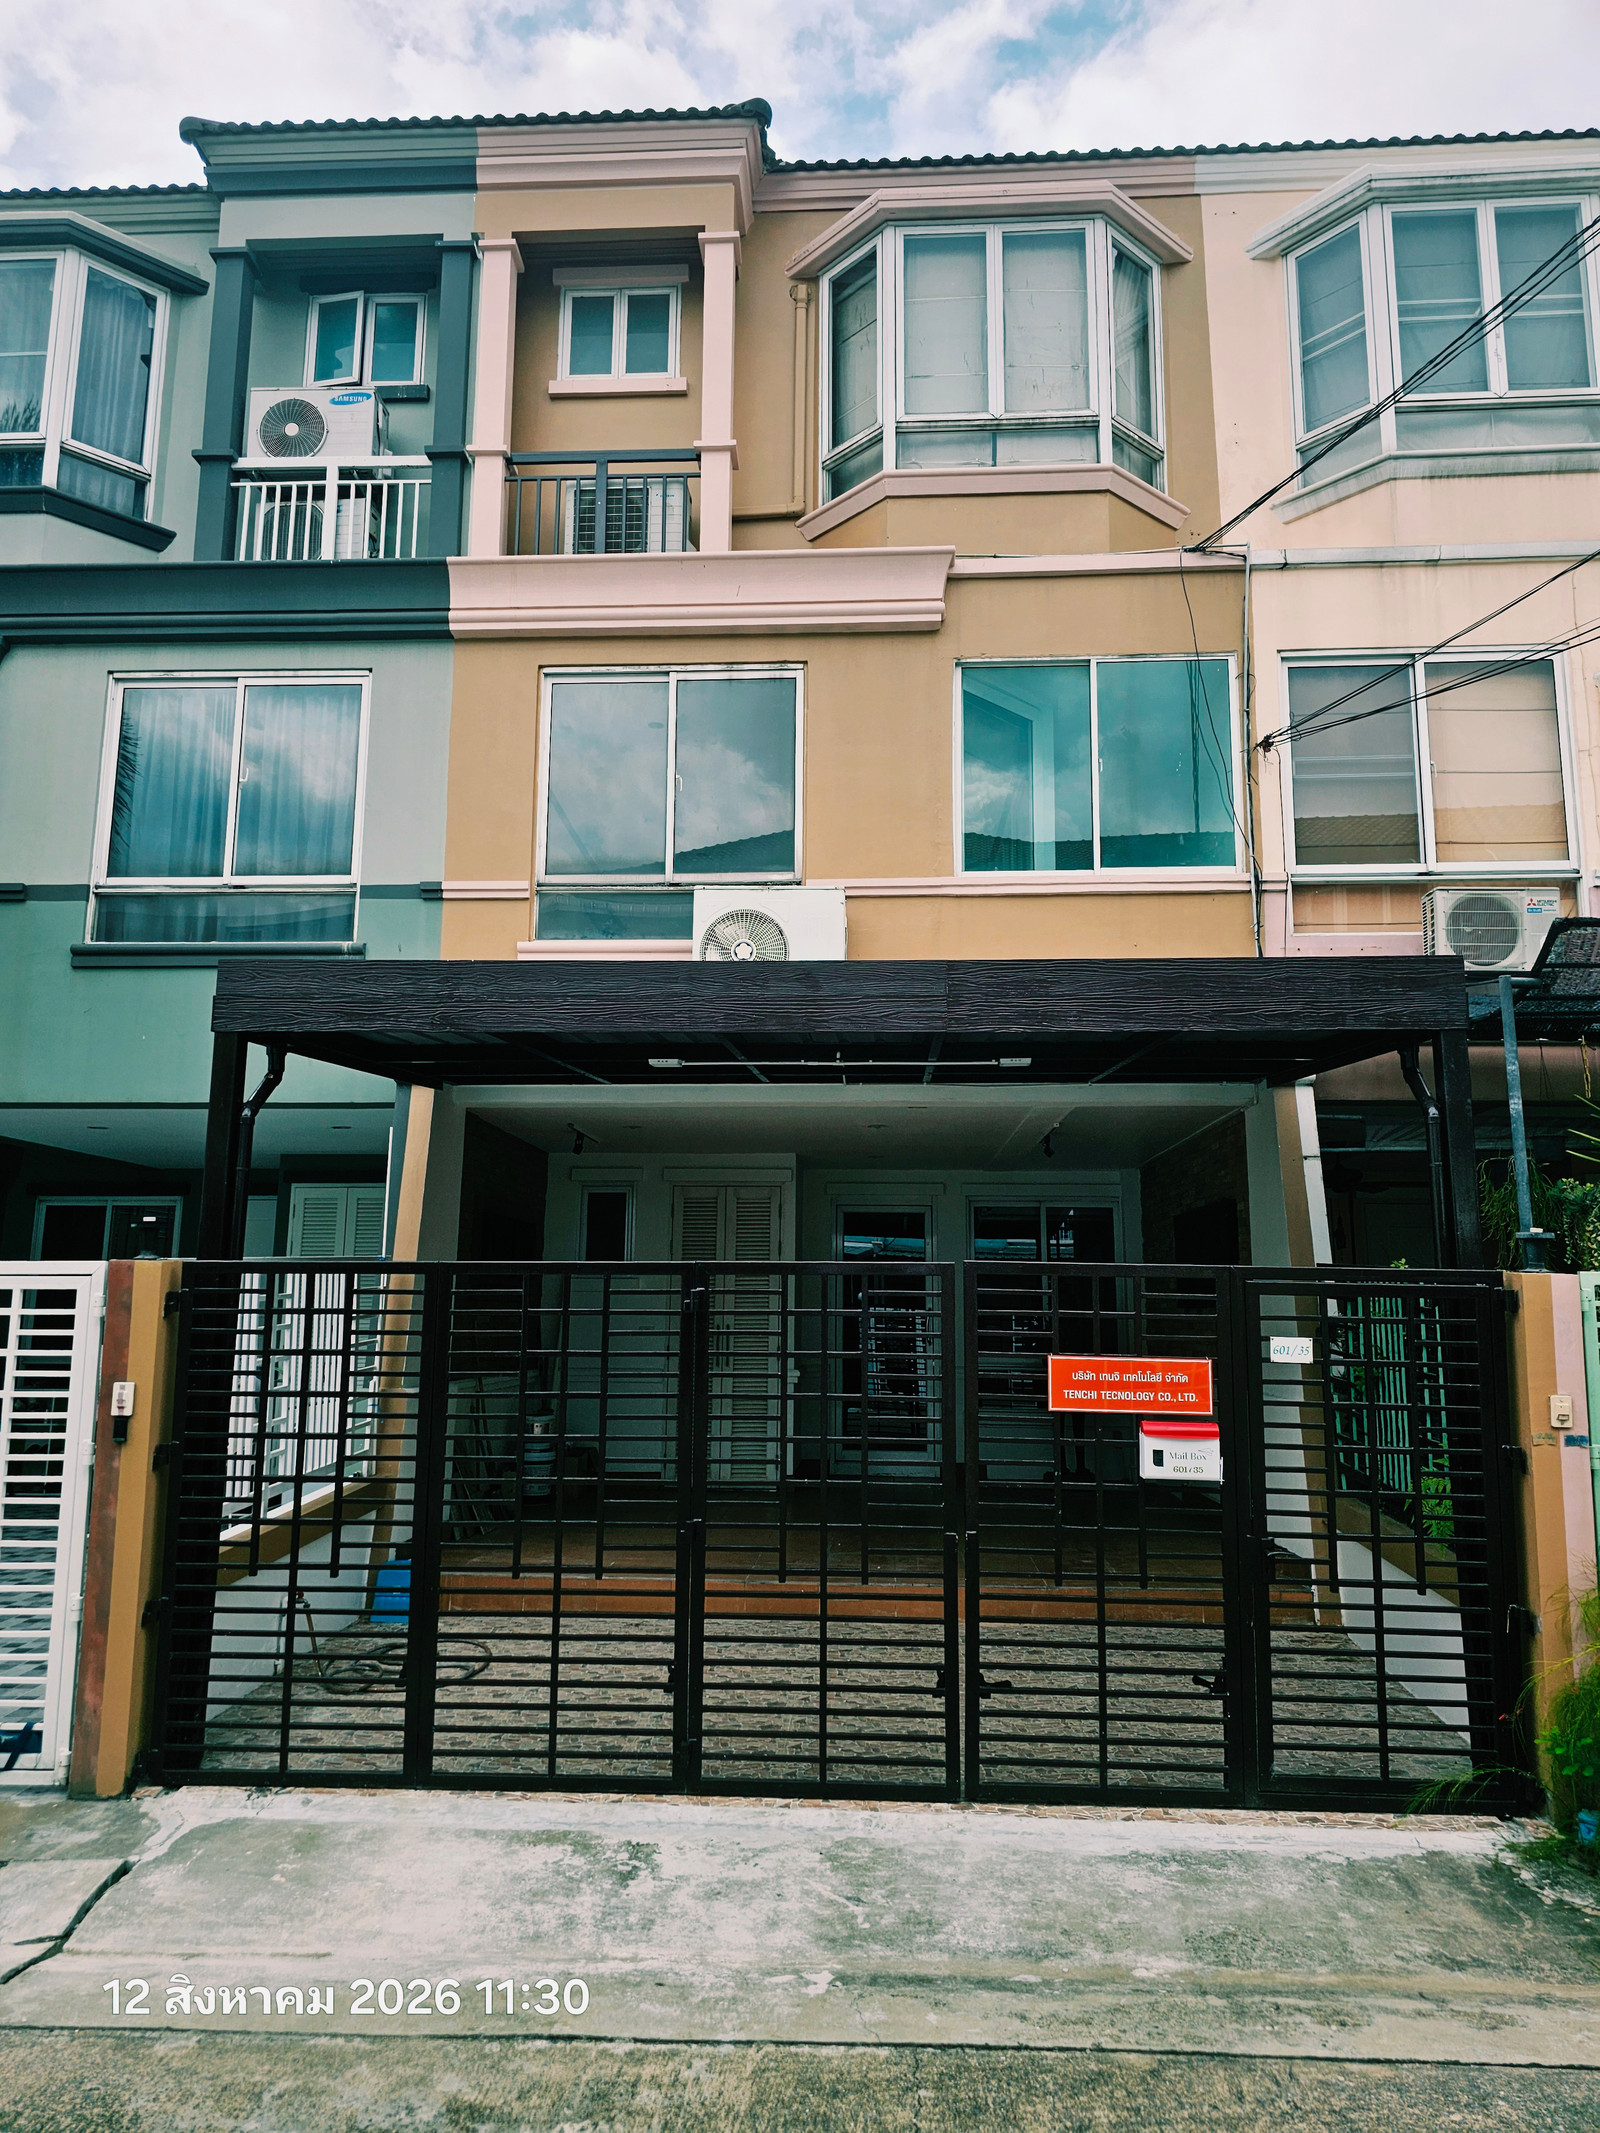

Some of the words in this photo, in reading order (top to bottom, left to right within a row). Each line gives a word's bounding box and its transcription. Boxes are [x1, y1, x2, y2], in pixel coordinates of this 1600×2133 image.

[1272, 1345, 1310, 1357] 601/35
[1072, 1370, 1096, 1381] บริษัท
[1099, 1371, 1120, 1381] เทนจิ
[1123, 1371, 1162, 1383] เทคโนโลยี
[1165, 1372, 1189, 1383] จำกัด
[1063, 1389, 1097, 1400] TENCHI
[1100, 1390, 1155, 1401] TECNOLOGY
[1158, 1392, 1177, 1403] CO.,
[1178, 1392, 1199, 1402] LTD.
[1169, 1451, 1188, 1460] Mail
[1190, 1452, 1207, 1461] Box
